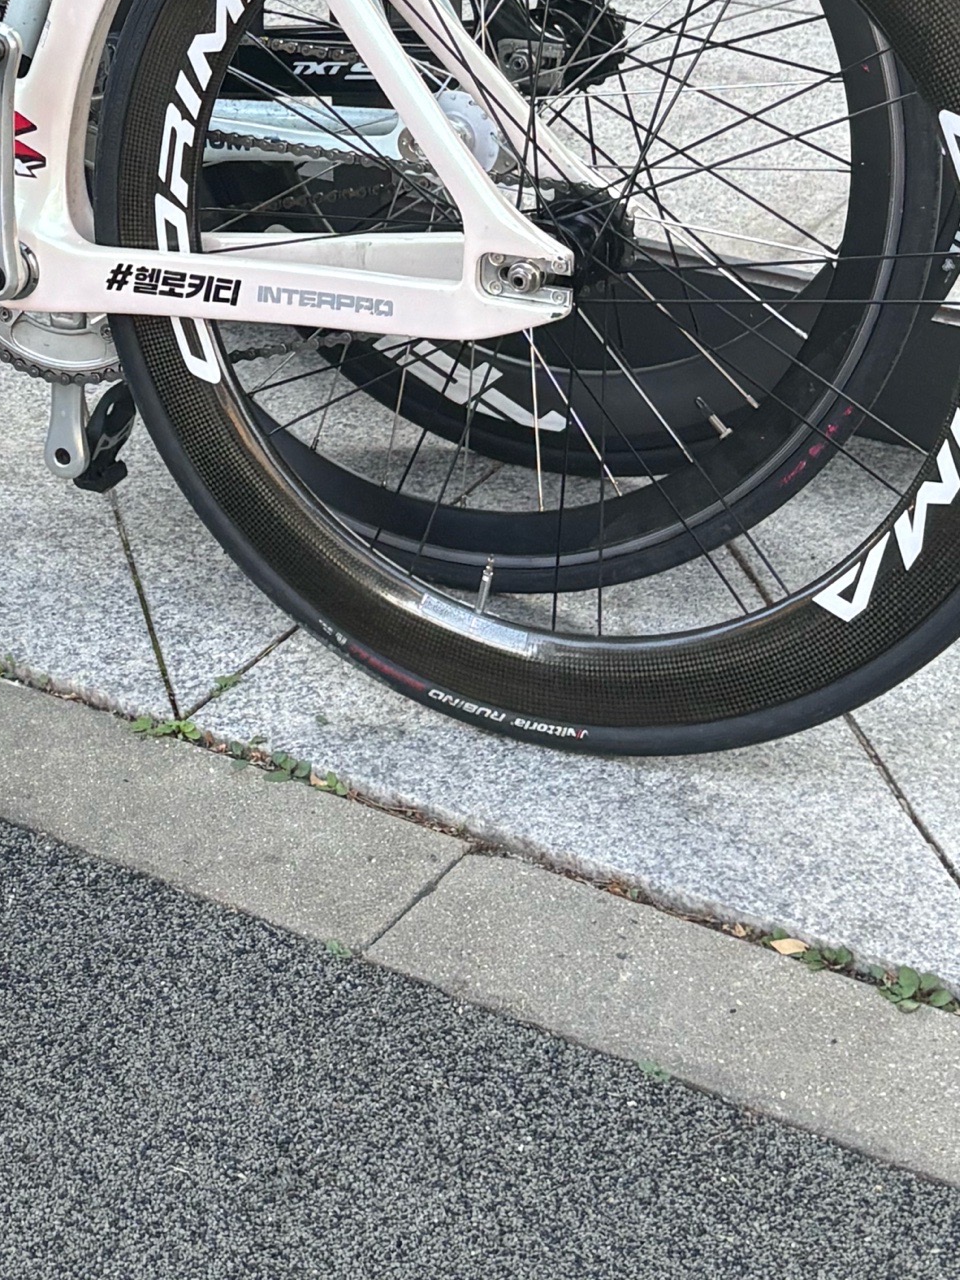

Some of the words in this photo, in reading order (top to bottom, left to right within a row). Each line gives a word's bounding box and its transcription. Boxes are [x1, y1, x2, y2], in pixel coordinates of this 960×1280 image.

[293, 61, 349, 75] TXT
[106, 262, 242, 307] #헬로키티
[257, 285, 394, 317] INTERPRO
[427, 688, 507, 723] RUBINO
